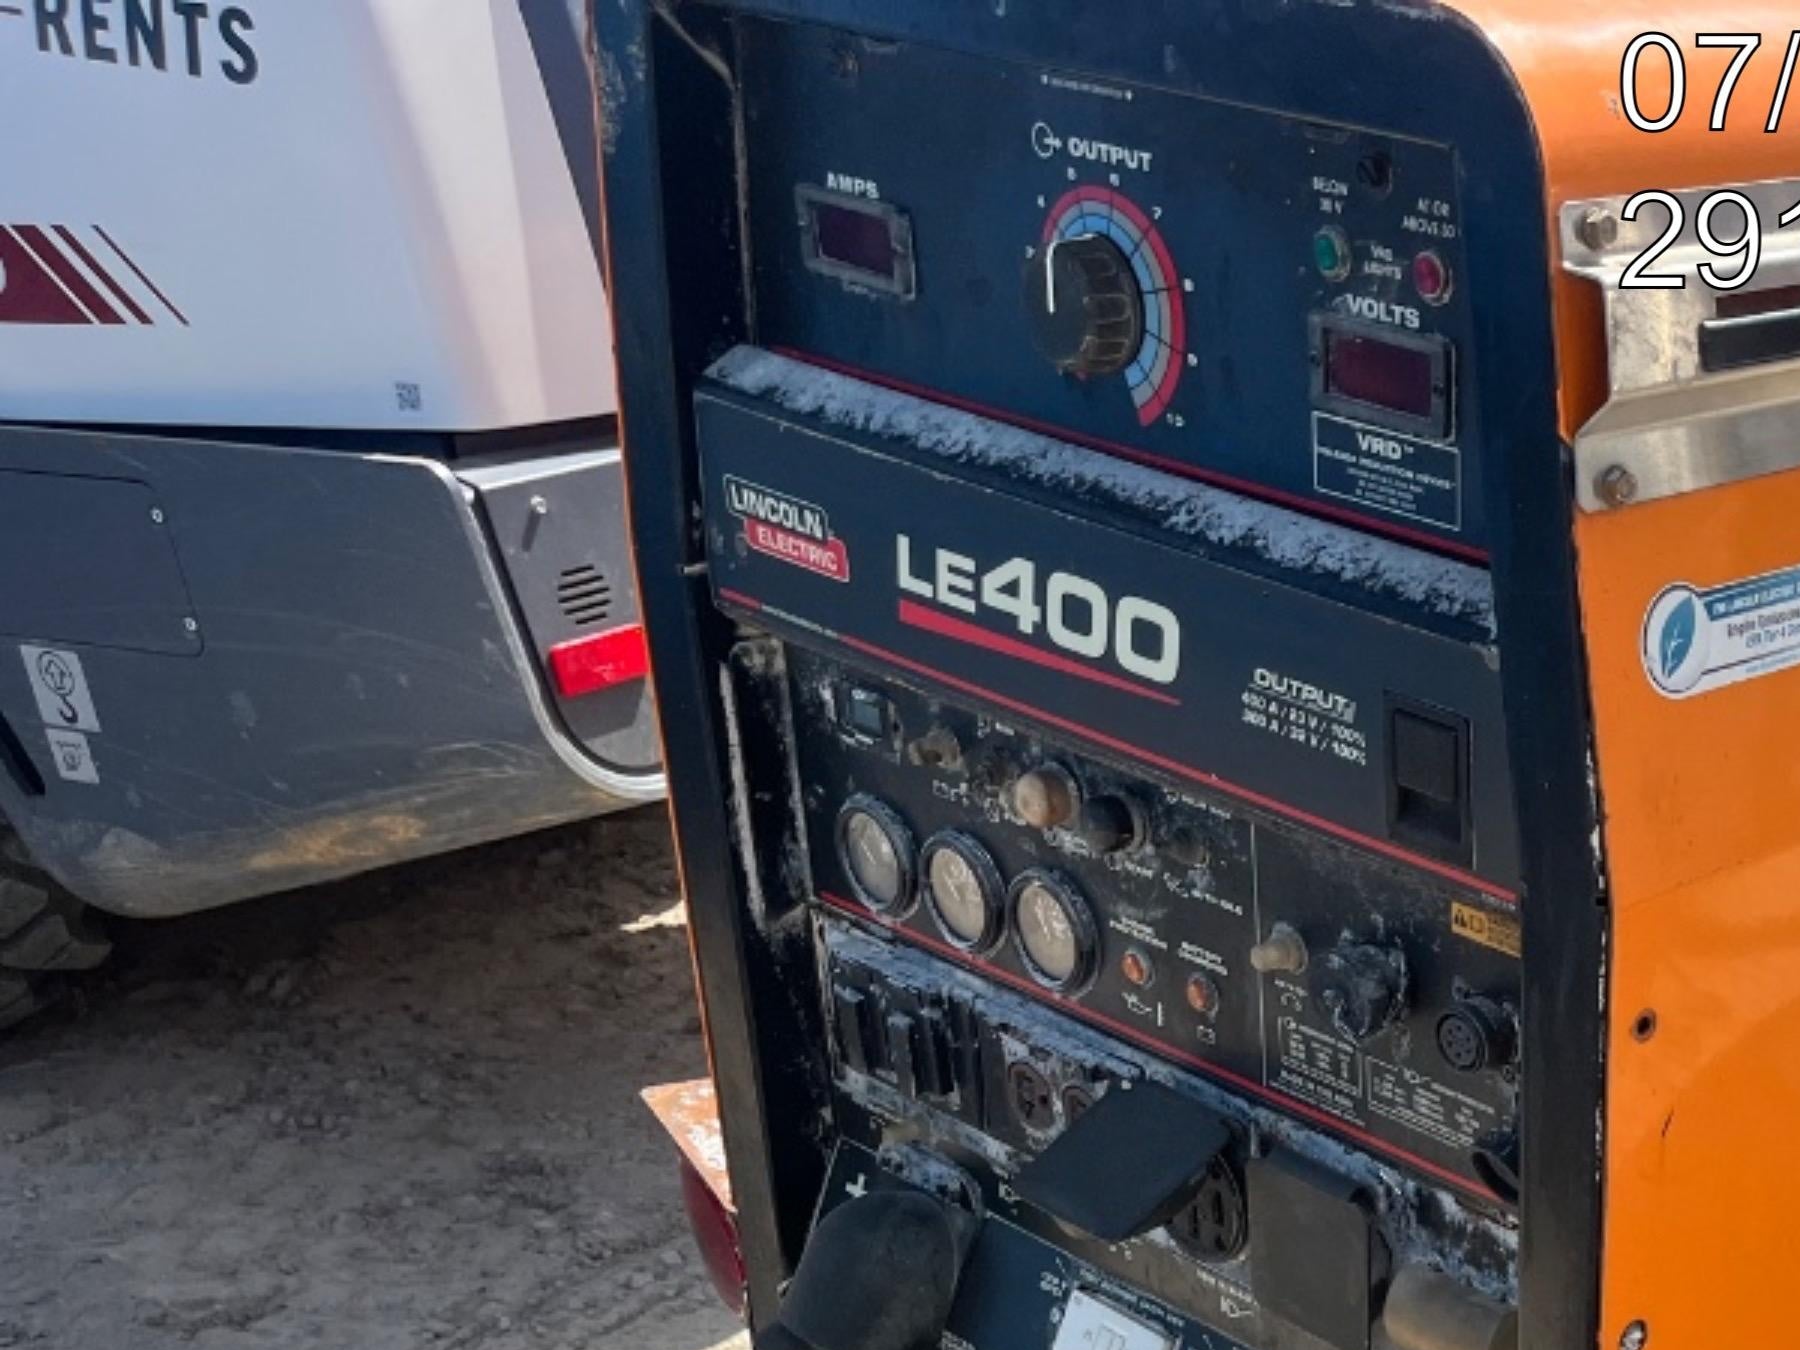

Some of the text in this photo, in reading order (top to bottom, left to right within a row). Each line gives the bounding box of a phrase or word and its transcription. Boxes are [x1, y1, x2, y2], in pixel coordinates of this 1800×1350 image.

[1066, 136, 1153, 172] OUTPUT
[826, 171, 880, 199] AMPS
[1345, 294, 1421, 329] VOLTS
[731, 482, 824, 541] LINCOLN
[756, 525, 838, 572] ELECTRIC
[896, 533, 1181, 685] LE400
[1253, 668, 1350, 712] OUTPUT
